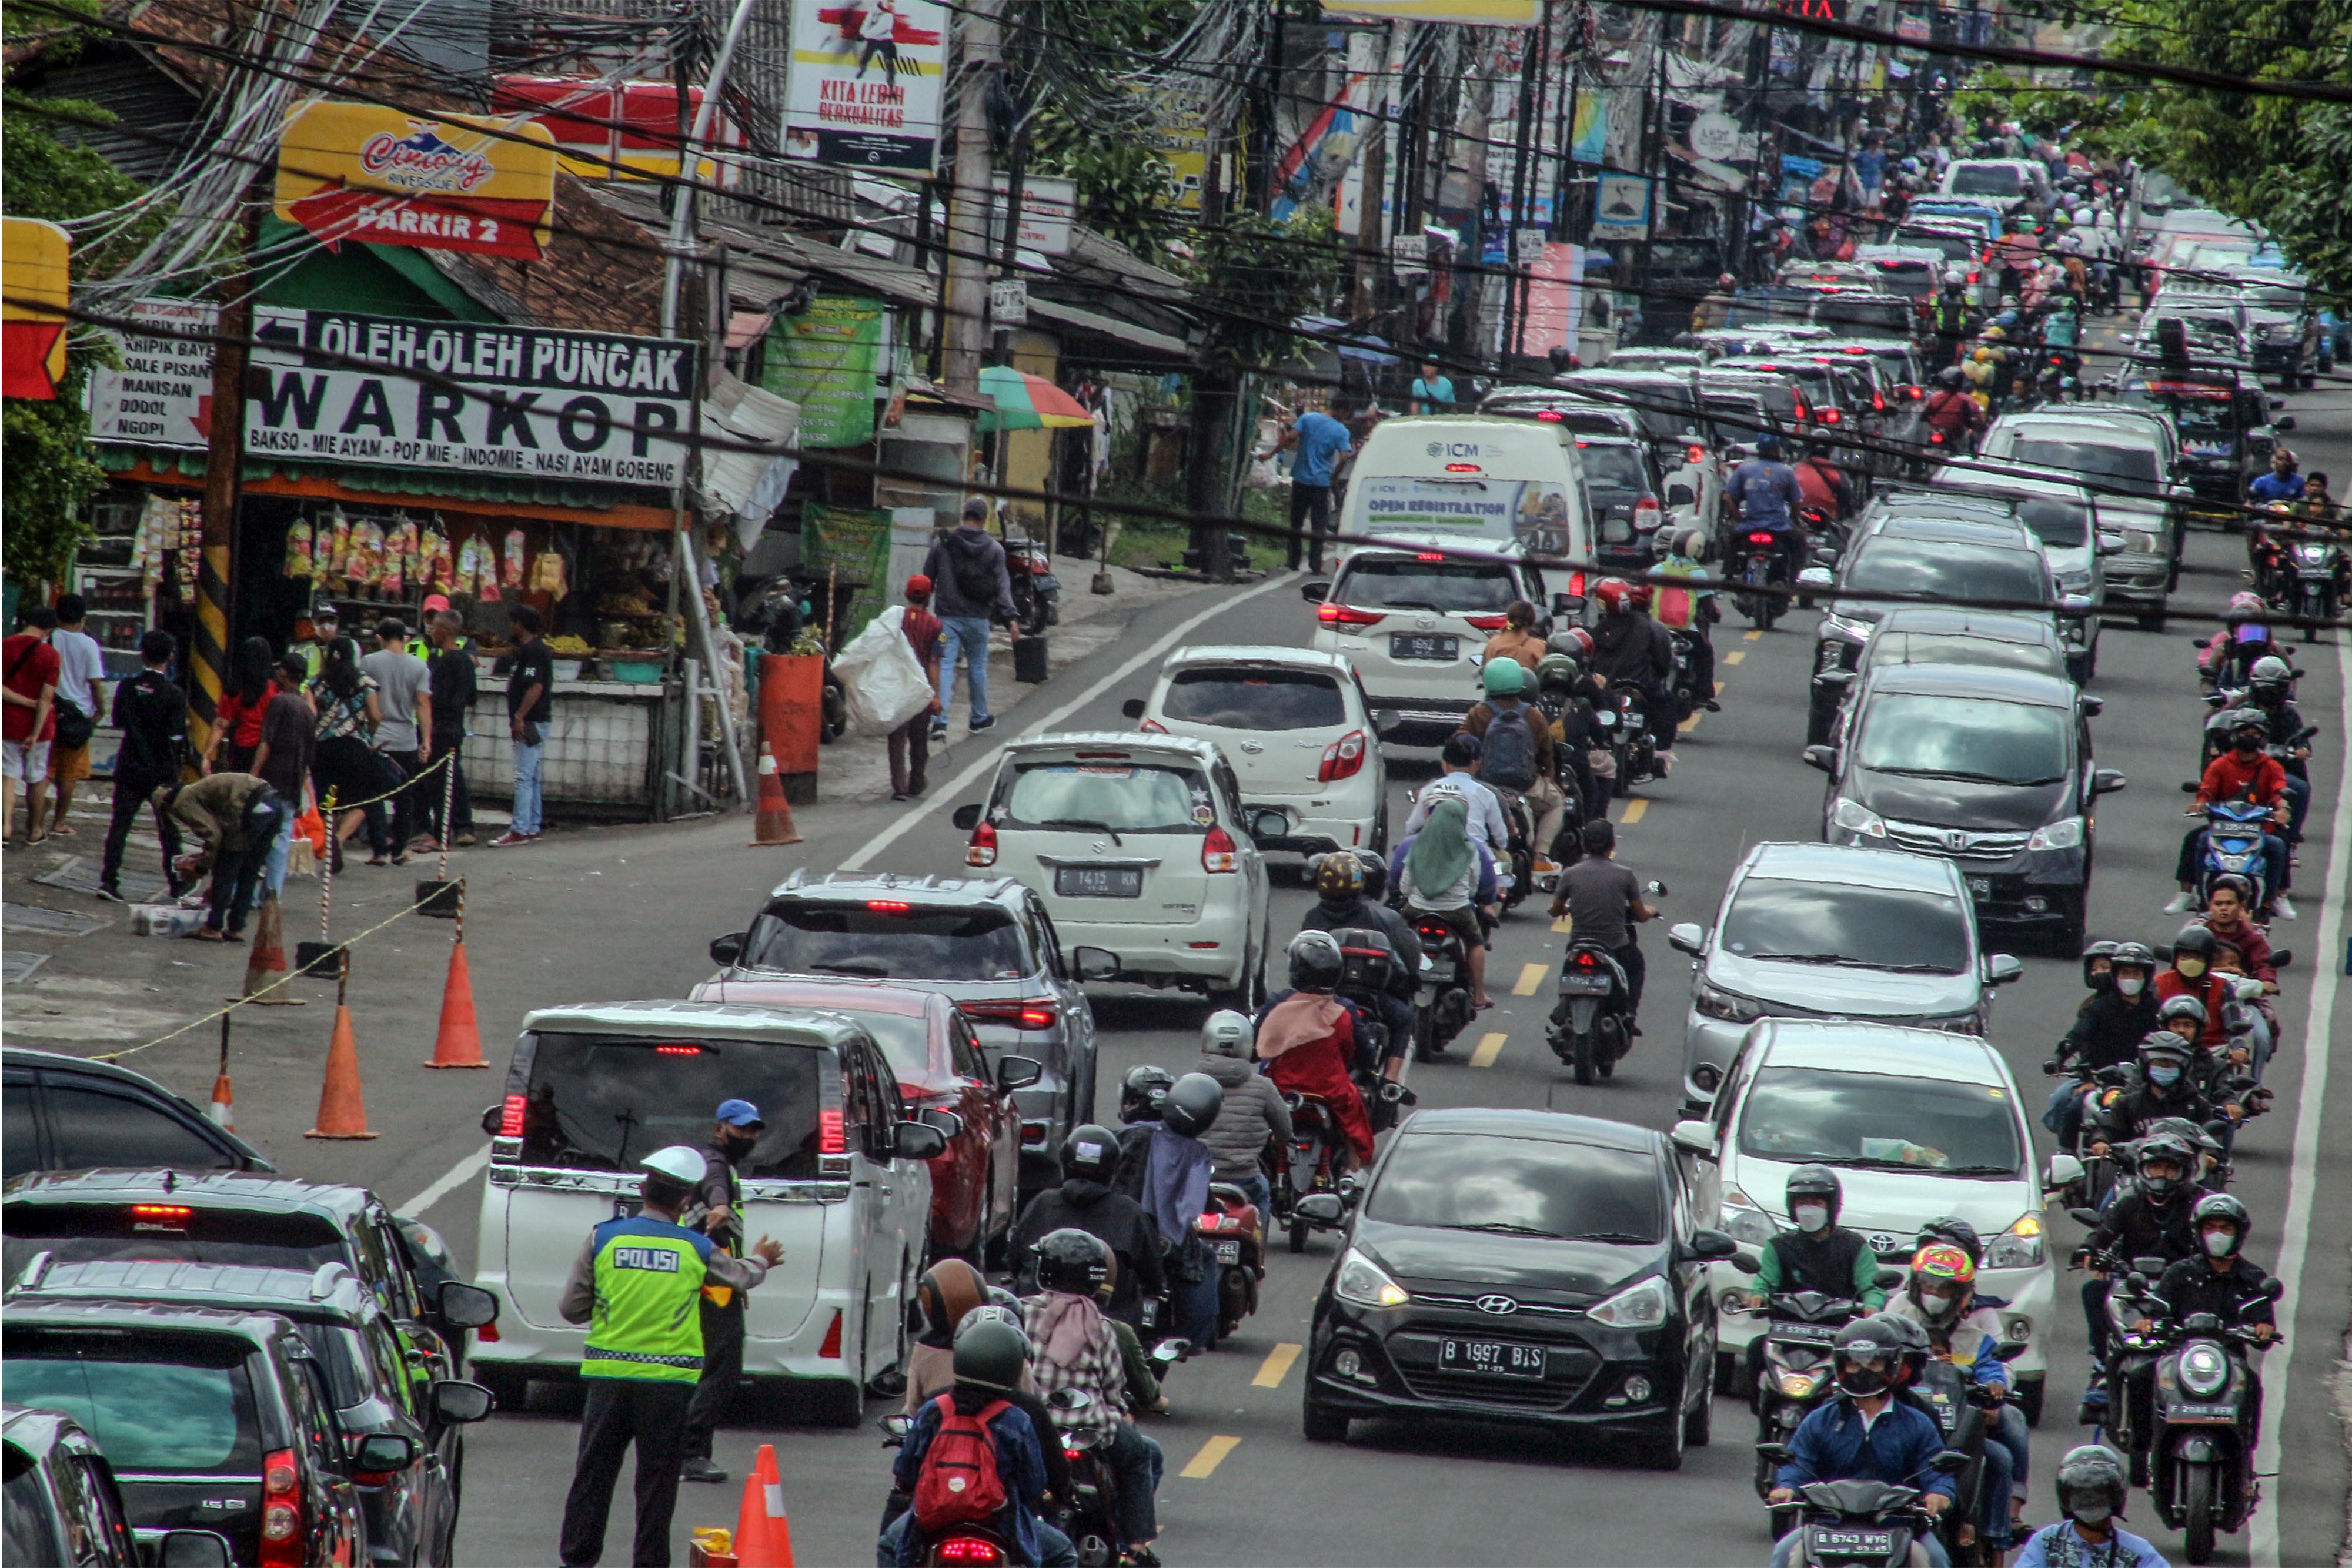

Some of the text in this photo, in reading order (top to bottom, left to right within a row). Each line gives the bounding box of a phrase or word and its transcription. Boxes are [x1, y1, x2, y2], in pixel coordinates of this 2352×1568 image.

[820, 79, 906, 106] KITA LEBIH
[819, 102, 904, 129] BERKUALITAS
[362, 133, 494, 192] Cimory
[356, 207, 499, 242] PARKIR 2
[177, 342, 217, 357] BAYE
[320, 318, 683, 392] OLEH-OLEH PUNCAK
[125, 357, 213, 379] SALE PISAN
[122, 377, 192, 398] MANISAN
[119, 399, 167, 416] DODOL
[262, 370, 677, 458] WARKOP
[117, 419, 165, 436] NGOPI
[250, 429, 674, 482] BAKSO MIE AYAM POP MIE INDOMIE NASI AYAM GORENG
[1446, 443, 1479, 457] ICM
[1369, 499, 1506, 516] OPEN REGISTRATION
[1060, 871, 1067, 884] F
[1079, 871, 1107, 885] 1415
[615, 1247, 678, 1272] POLISI
[1445, 1341, 1455, 1360] B
[1465, 1343, 1499, 1364] 1997
[1832, 1534, 1860, 1544] 6743
